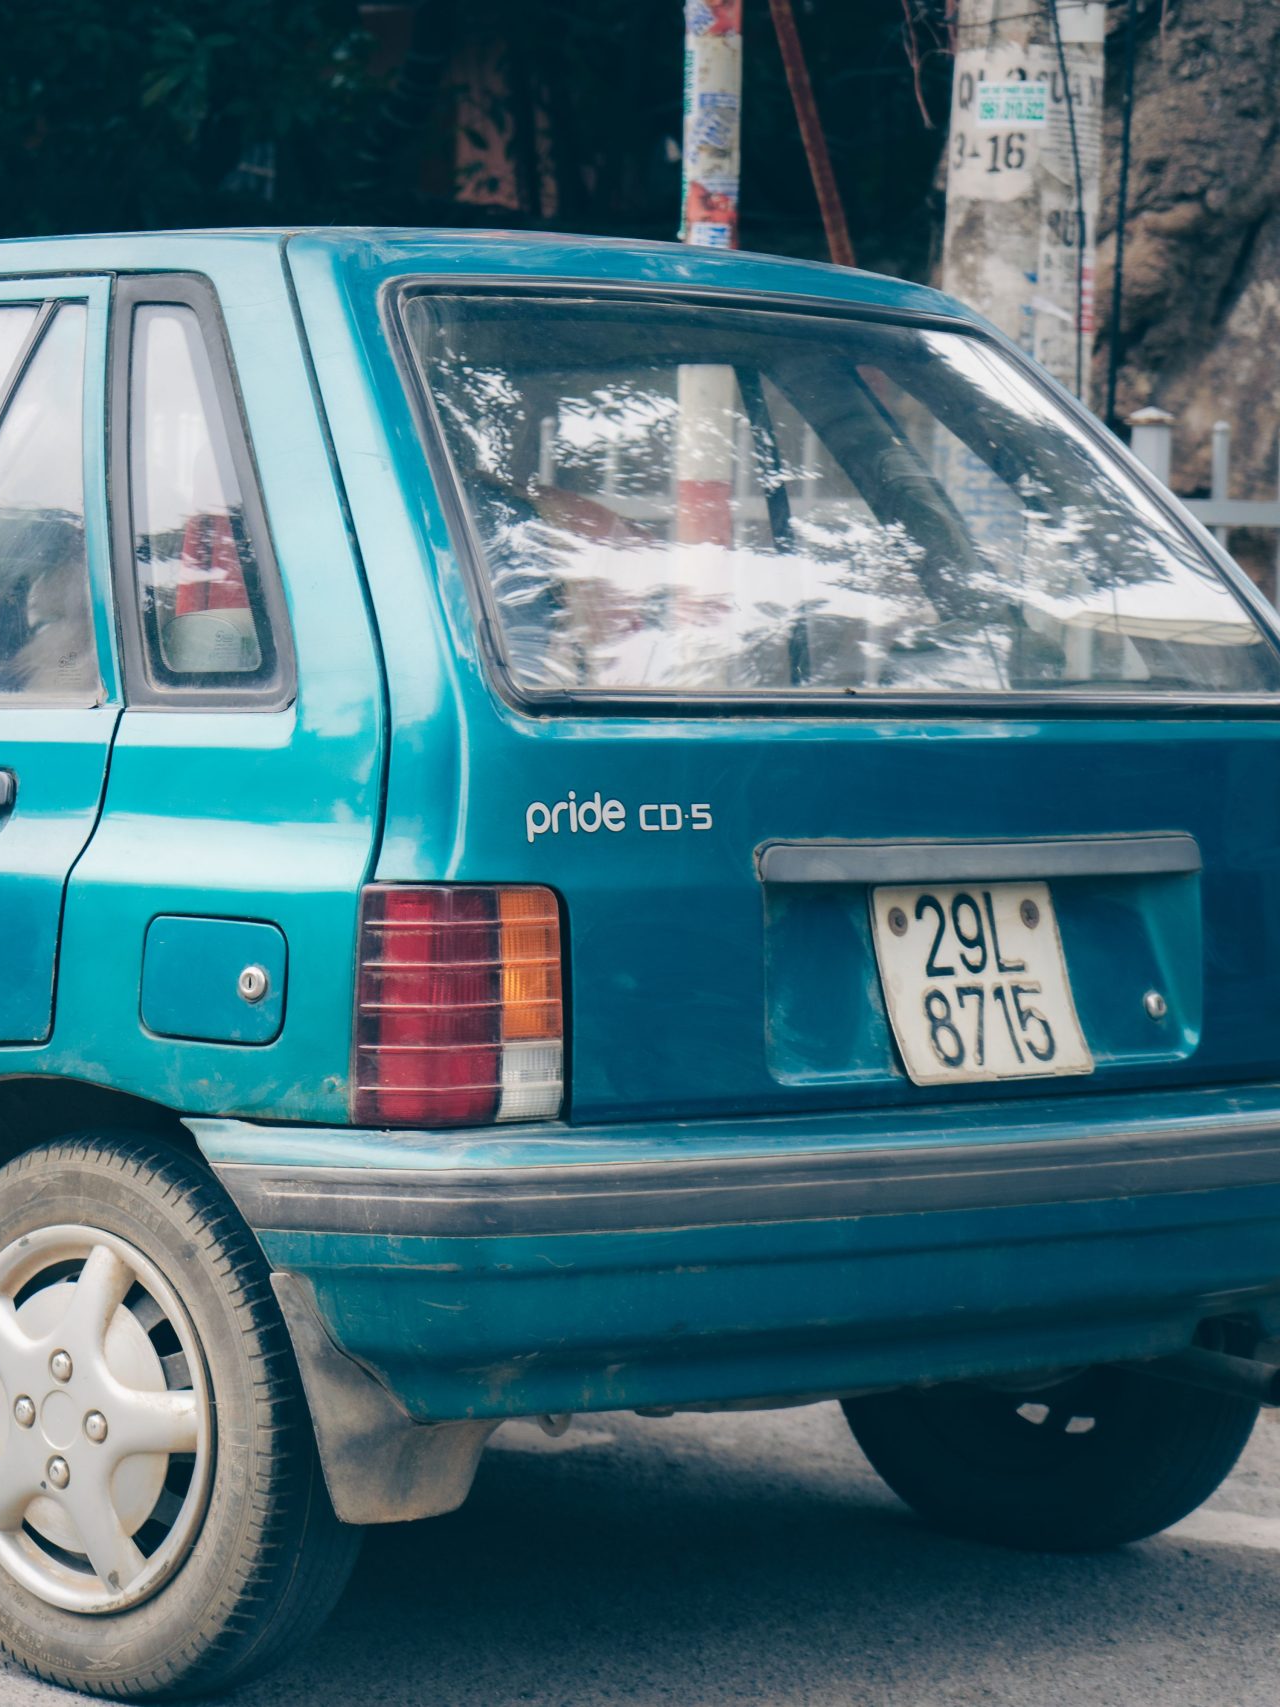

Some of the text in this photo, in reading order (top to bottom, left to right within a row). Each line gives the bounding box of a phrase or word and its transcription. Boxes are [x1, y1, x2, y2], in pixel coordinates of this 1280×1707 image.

[526, 790, 626, 843] pride
[915, 891, 1026, 978] 29L
[924, 982, 1056, 1068] 8715
